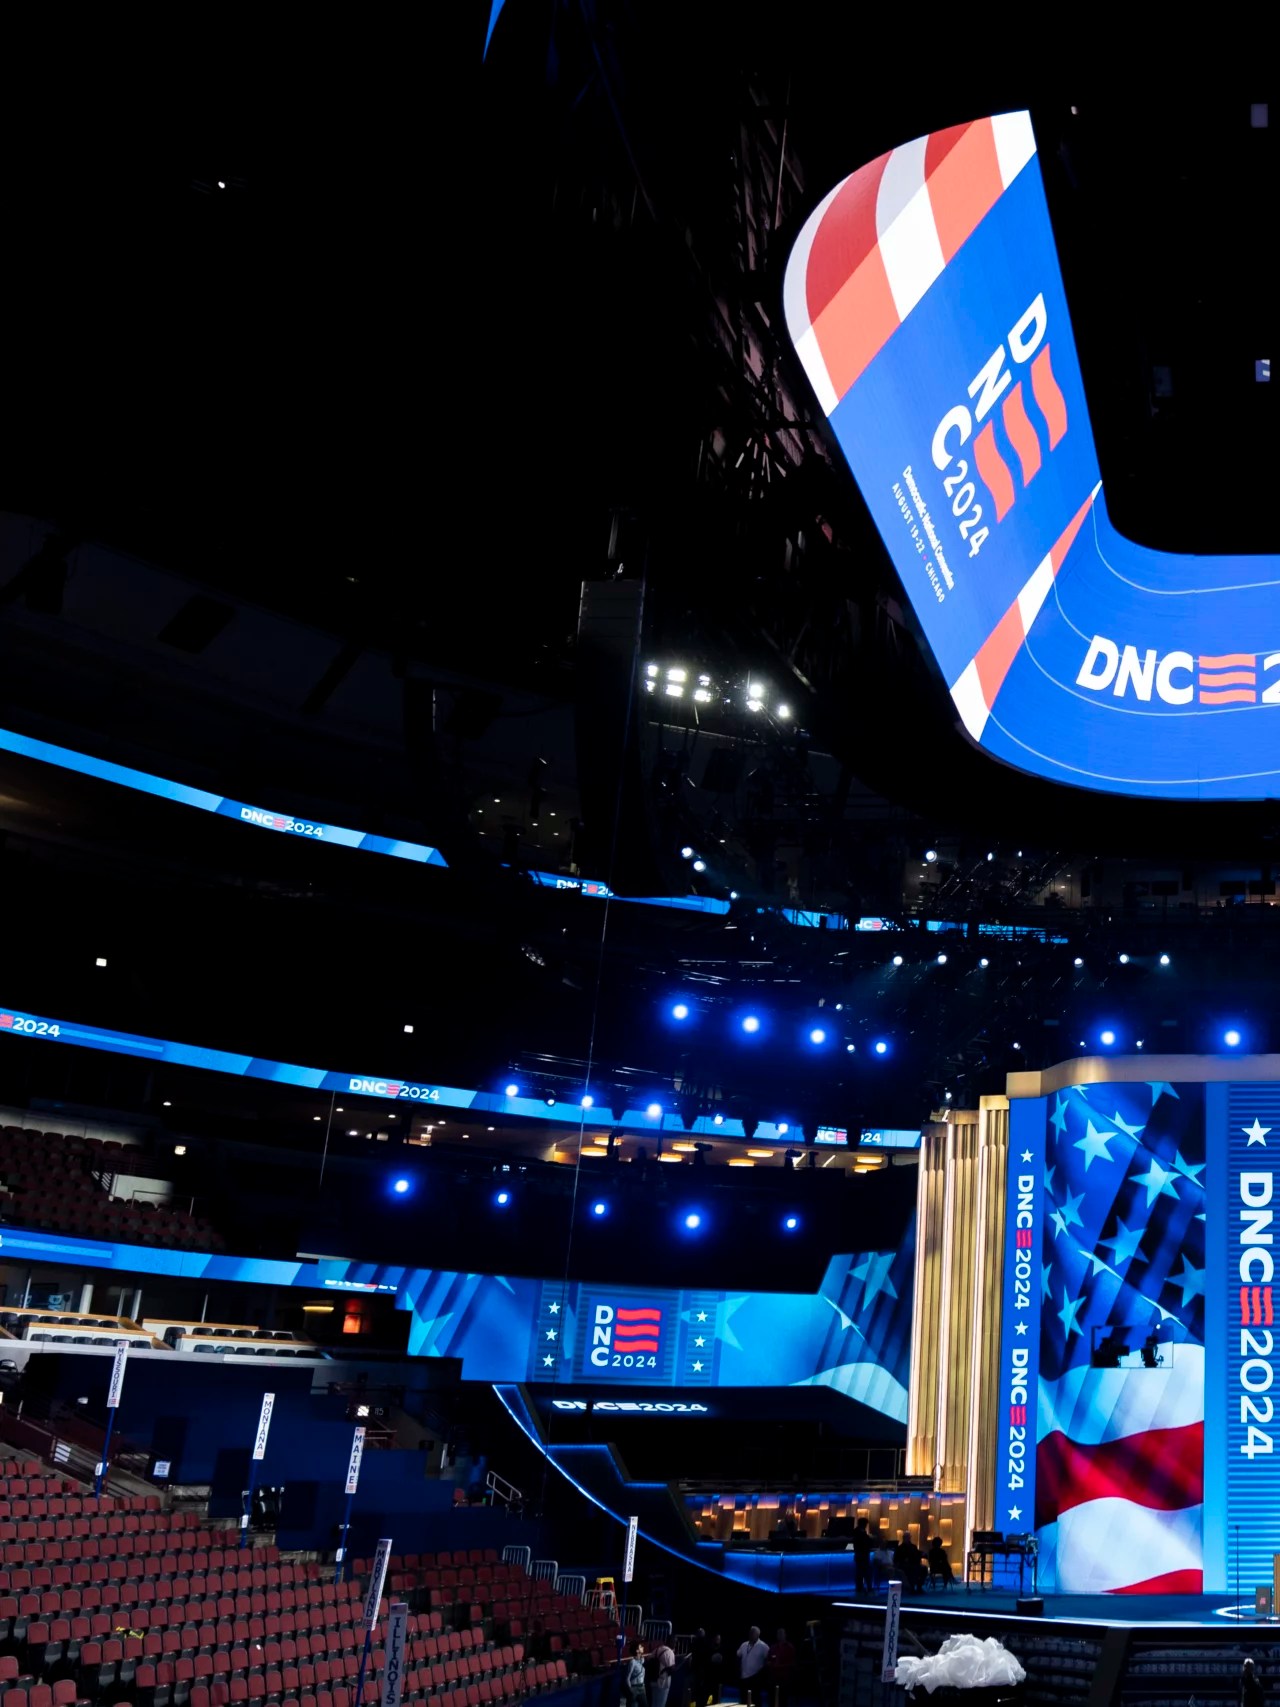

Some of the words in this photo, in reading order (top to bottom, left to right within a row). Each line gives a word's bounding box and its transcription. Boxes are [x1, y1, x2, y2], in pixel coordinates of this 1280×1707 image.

[943, 459, 990, 558] 2024
[892, 482, 914, 525] AUGUST
[910, 524, 926, 554] 19-22
[925, 561, 945, 603] CHICAGO
[284, 820, 324, 837] 2024
[12, 1017, 60, 1038] 2024
[399, 1085, 440, 1101] 2024
[1014, 1249, 1032, 1310] 2024
[111, 1347, 124, 1398] MISSOURI
[611, 1354, 657, 1368] 2024
[1239, 1328, 1274, 1459] 2024
[256, 1400, 272, 1450] MONTANA
[348, 1434, 362, 1484] MAINE
[1008, 1426, 1026, 1491] 2024
[365, 1550, 385, 1618] MARYLAND
[385, 1616, 402, 1705] ILLINOIS
[886, 1593, 898, 1668] CALIFORNIA
